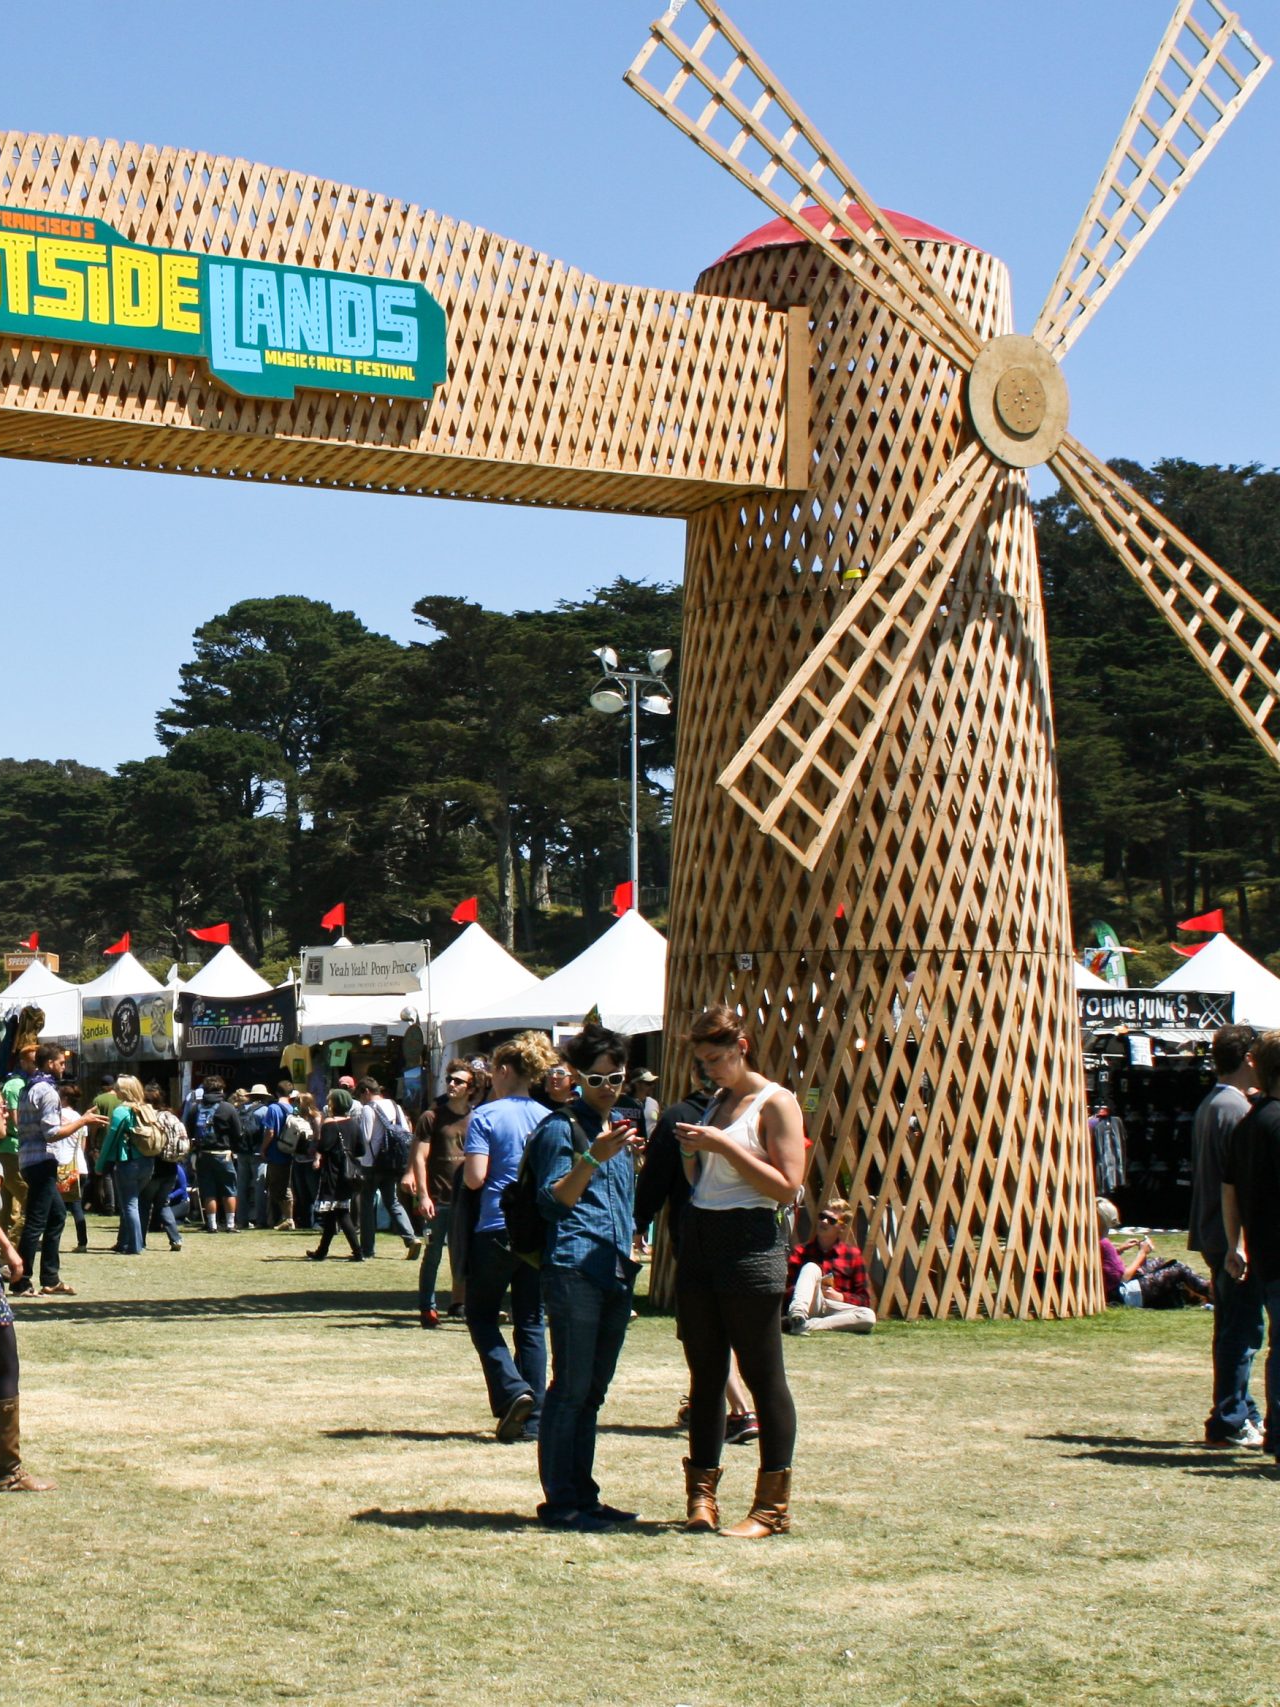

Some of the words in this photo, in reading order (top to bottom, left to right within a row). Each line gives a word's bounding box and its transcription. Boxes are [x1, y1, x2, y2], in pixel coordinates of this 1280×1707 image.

[209, 263, 418, 373] LANDS
[265, 350, 308, 369] MUSIC
[317, 356, 352, 374] ARTS
[355, 360, 415, 381] FESTIVAL
[330, 963, 349, 976] Yeah
[351, 960, 368, 976] Yeah!
[371, 961, 391, 979] Pony
[392, 960, 417, 974] Prnce
[1078, 996, 1137, 1019] YOUNG
[1138, 993, 1188, 1022] PUNKS
[82, 1023, 109, 1040] Sandals
